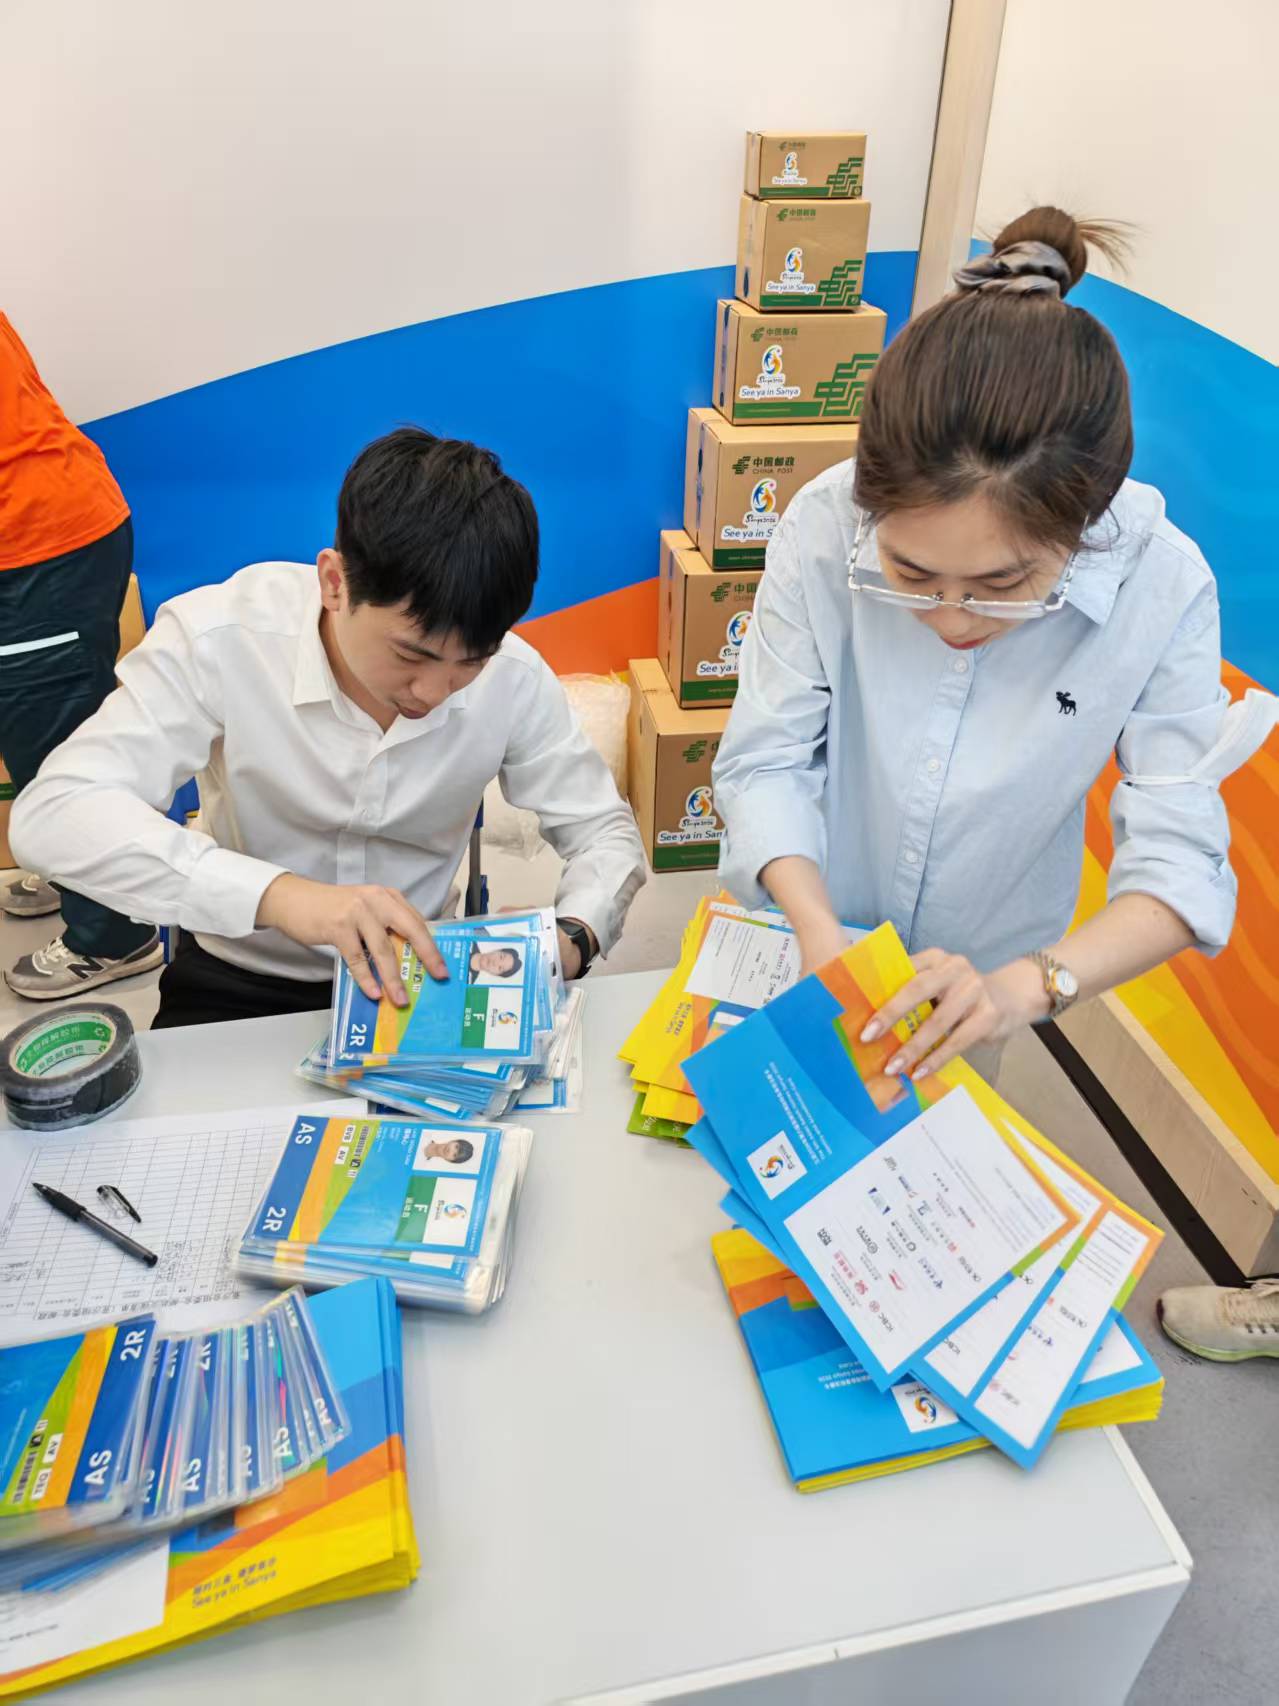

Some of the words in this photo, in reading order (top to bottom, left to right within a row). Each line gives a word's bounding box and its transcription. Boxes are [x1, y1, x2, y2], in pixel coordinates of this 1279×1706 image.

[780, 285, 788, 293] ya
[797, 284, 815, 292] Sanya
[742, 389, 755, 397] See
[757, 390, 766, 398] ya
[776, 388, 799, 397] Sanya
[753, 456, 794, 467] 中国邮政
[724, 529, 740, 537] See
[755, 529, 764, 537] in
[700, 664, 718, 673] See
[720, 665, 731, 674] ya
[679, 834, 690, 842] ya
[693, 832, 702, 840] in
[473, 1013, 485, 1022] F
[350, 1023, 368, 1047] 2R
[295, 1122, 317, 1145] AS
[338, 1150, 346, 1161] AV
[414, 1204, 428, 1213] F
[262, 1206, 288, 1232] 2R
[120, 1328, 146, 1362] 2R
[47, 1440, 59, 1456] AV
[275, 1427, 292, 1458] AS
[84, 1449, 113, 1485] AS
[184, 1458, 202, 1492] AS
